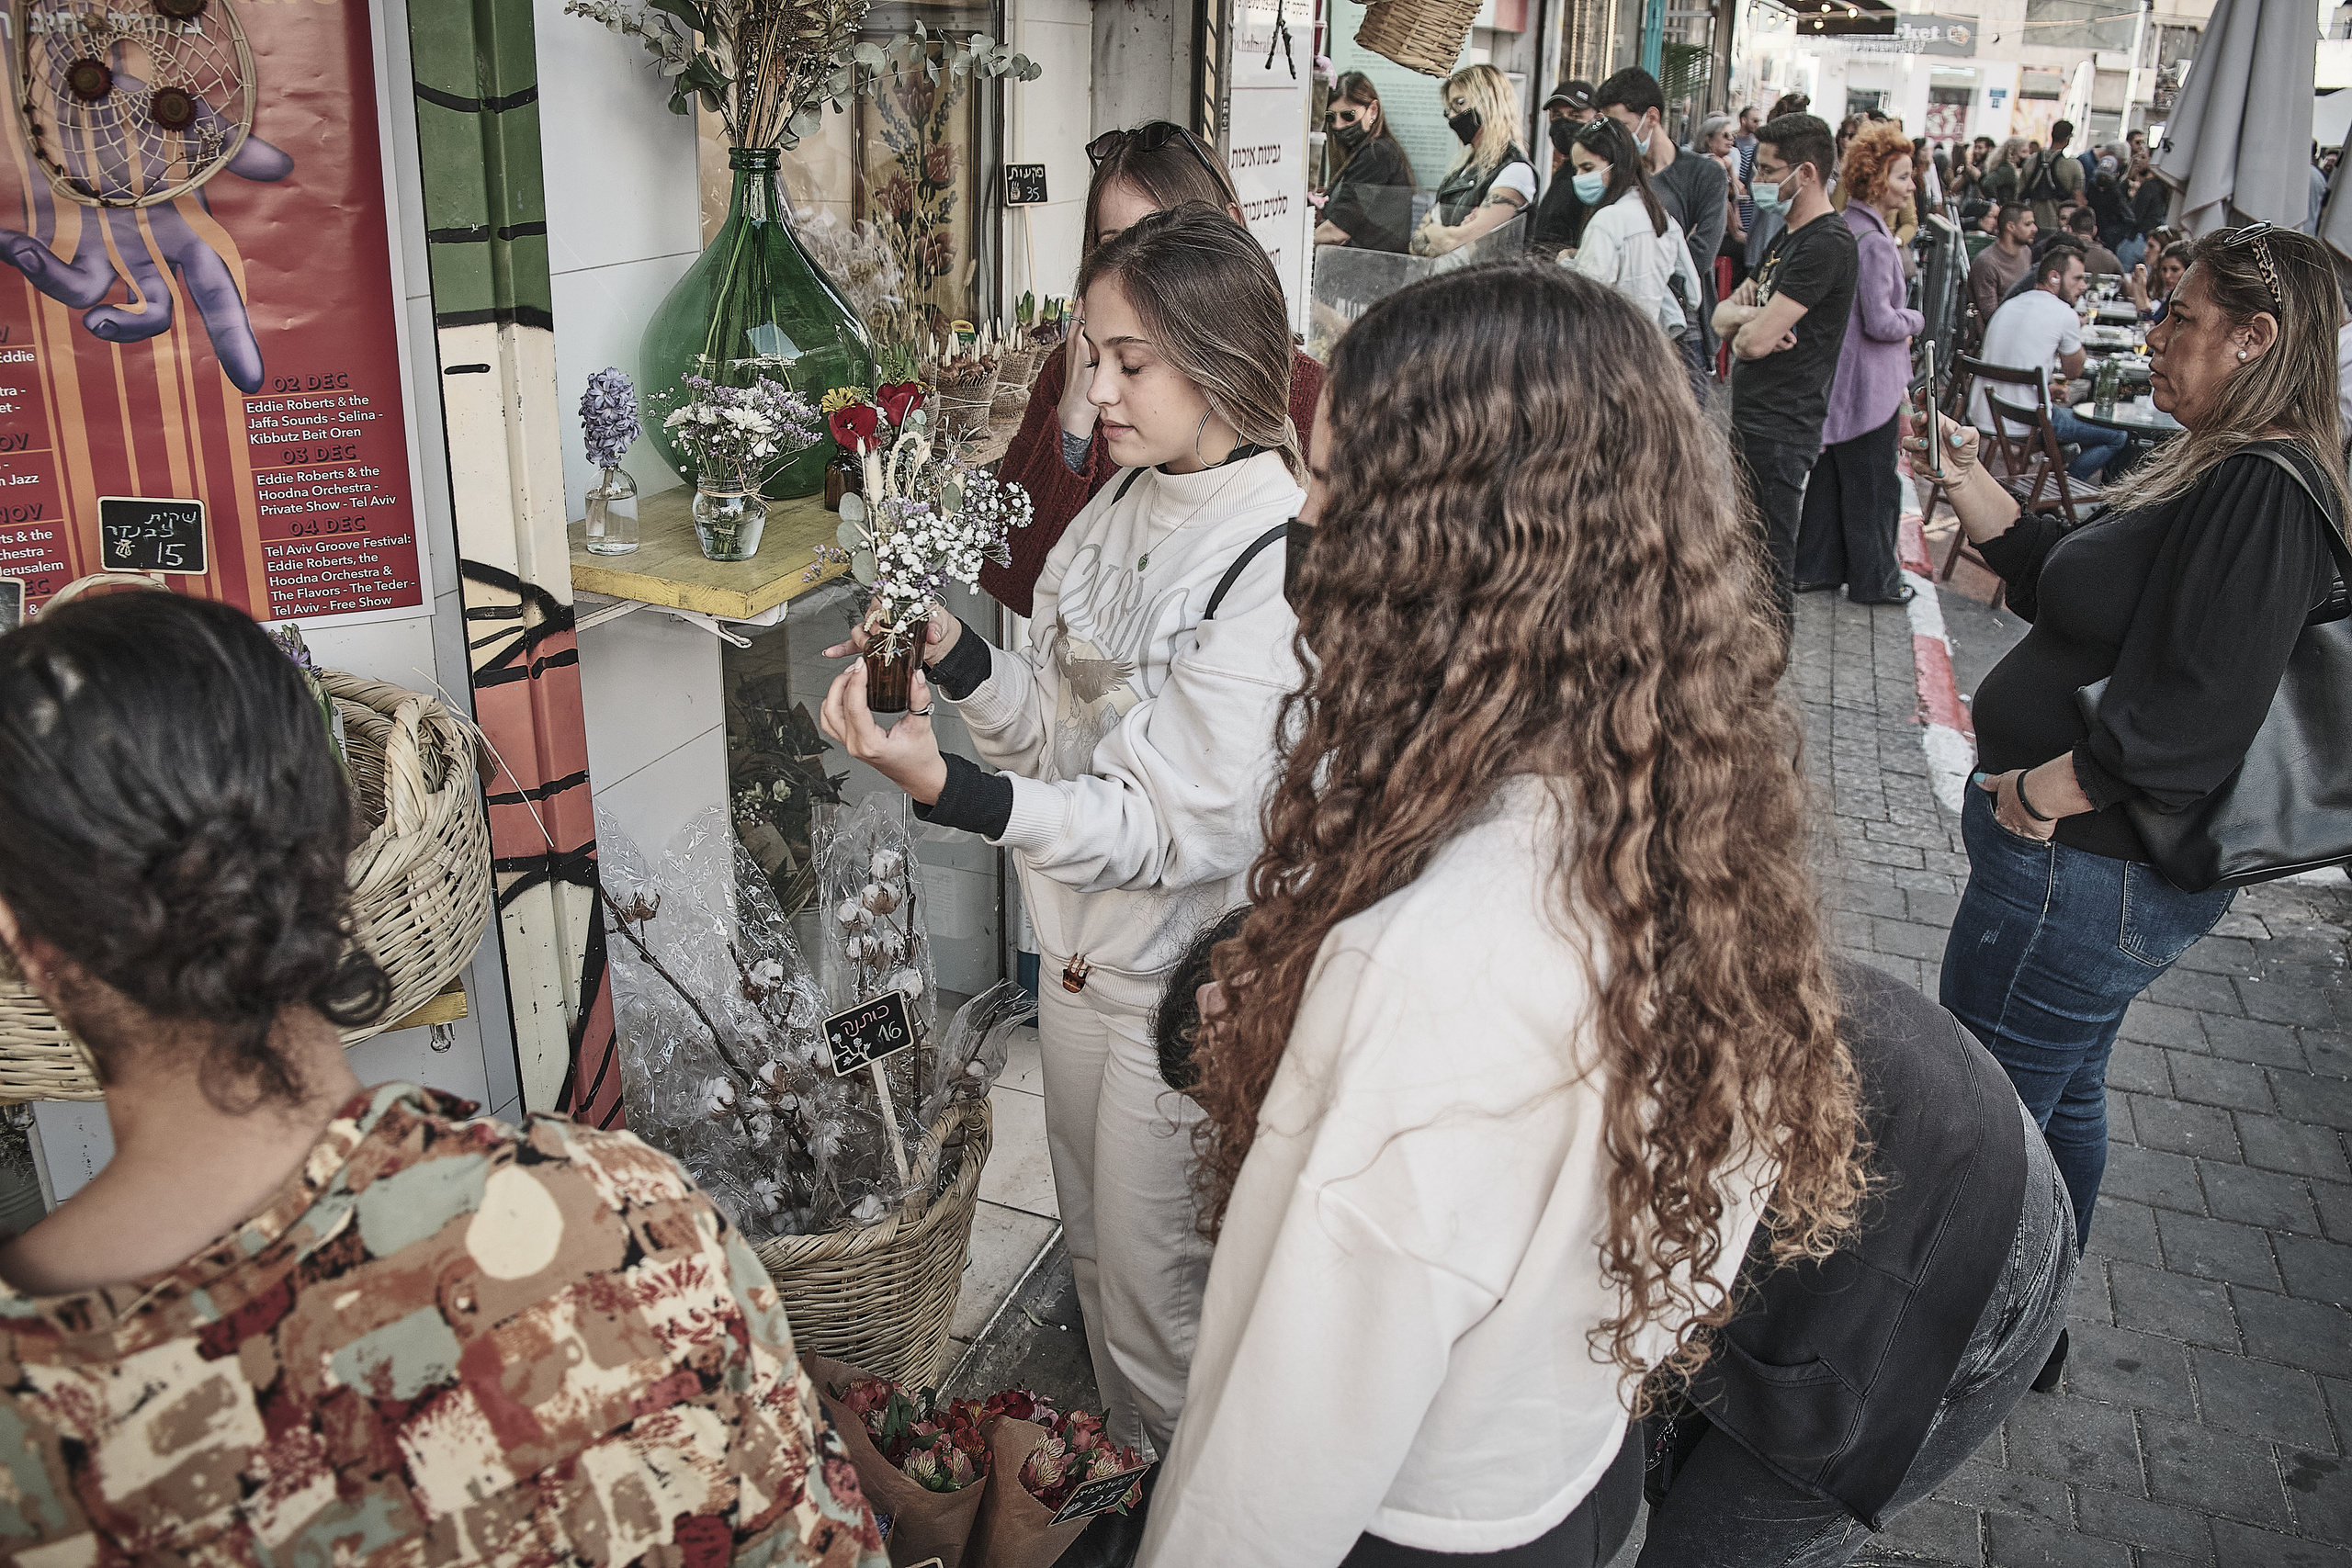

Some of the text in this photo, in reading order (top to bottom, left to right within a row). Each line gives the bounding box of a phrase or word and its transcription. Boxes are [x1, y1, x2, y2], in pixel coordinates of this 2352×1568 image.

[1231, 143, 1281, 169] גבינות איכות
[1008, 166, 1044, 185] פקעות
[1026, 186, 1040, 201] 35
[1264, 189, 1288, 218] סלטים
[273, 372, 349, 392] 02 DEC
[246, 394, 369, 413] Eddie Roberts & the
[248, 417, 278, 430] Jaffa
[281, 413, 328, 426] Sounds
[338, 412, 376, 423] Selina
[250, 428, 361, 445] Kibbutz Beit Oren
[281, 444, 356, 464] 03 DEC
[9, 473, 40, 486] Jazz
[257, 466, 380, 486] Eddie Roberts & the
[259, 488, 309, 501] Hoodna
[312, 483, 371, 496] Orchestra
[261, 501, 303, 516] Private
[306, 500, 340, 512] Show
[349, 497, 368, 508] Tel
[370, 495, 396, 506] Aviv
[144, 511, 198, 530] שקית
[289, 515, 366, 536] 04 DEC
[17, 531, 28, 542] &
[30, 529, 53, 540] the
[157, 541, 186, 567] 15
[265, 534, 412, 558] Tel Aviv Groove Festival:
[267, 553, 379, 572] Eddie Roberts, the
[269, 566, 392, 587] Hoodna Orchestra &
[271, 589, 294, 602] The
[297, 586, 341, 598] Flavors
[349, 581, 372, 593] The
[374, 579, 409, 591] Teder
[273, 605, 290, 616] Tel
[293, 604, 320, 615] Aviv
[330, 599, 356, 611] Free
[359, 597, 392, 608] Show
[840, 1005, 889, 1037] כותנה
[877, 1021, 902, 1042] 16
[1081, 1488, 1125, 1513] 35
